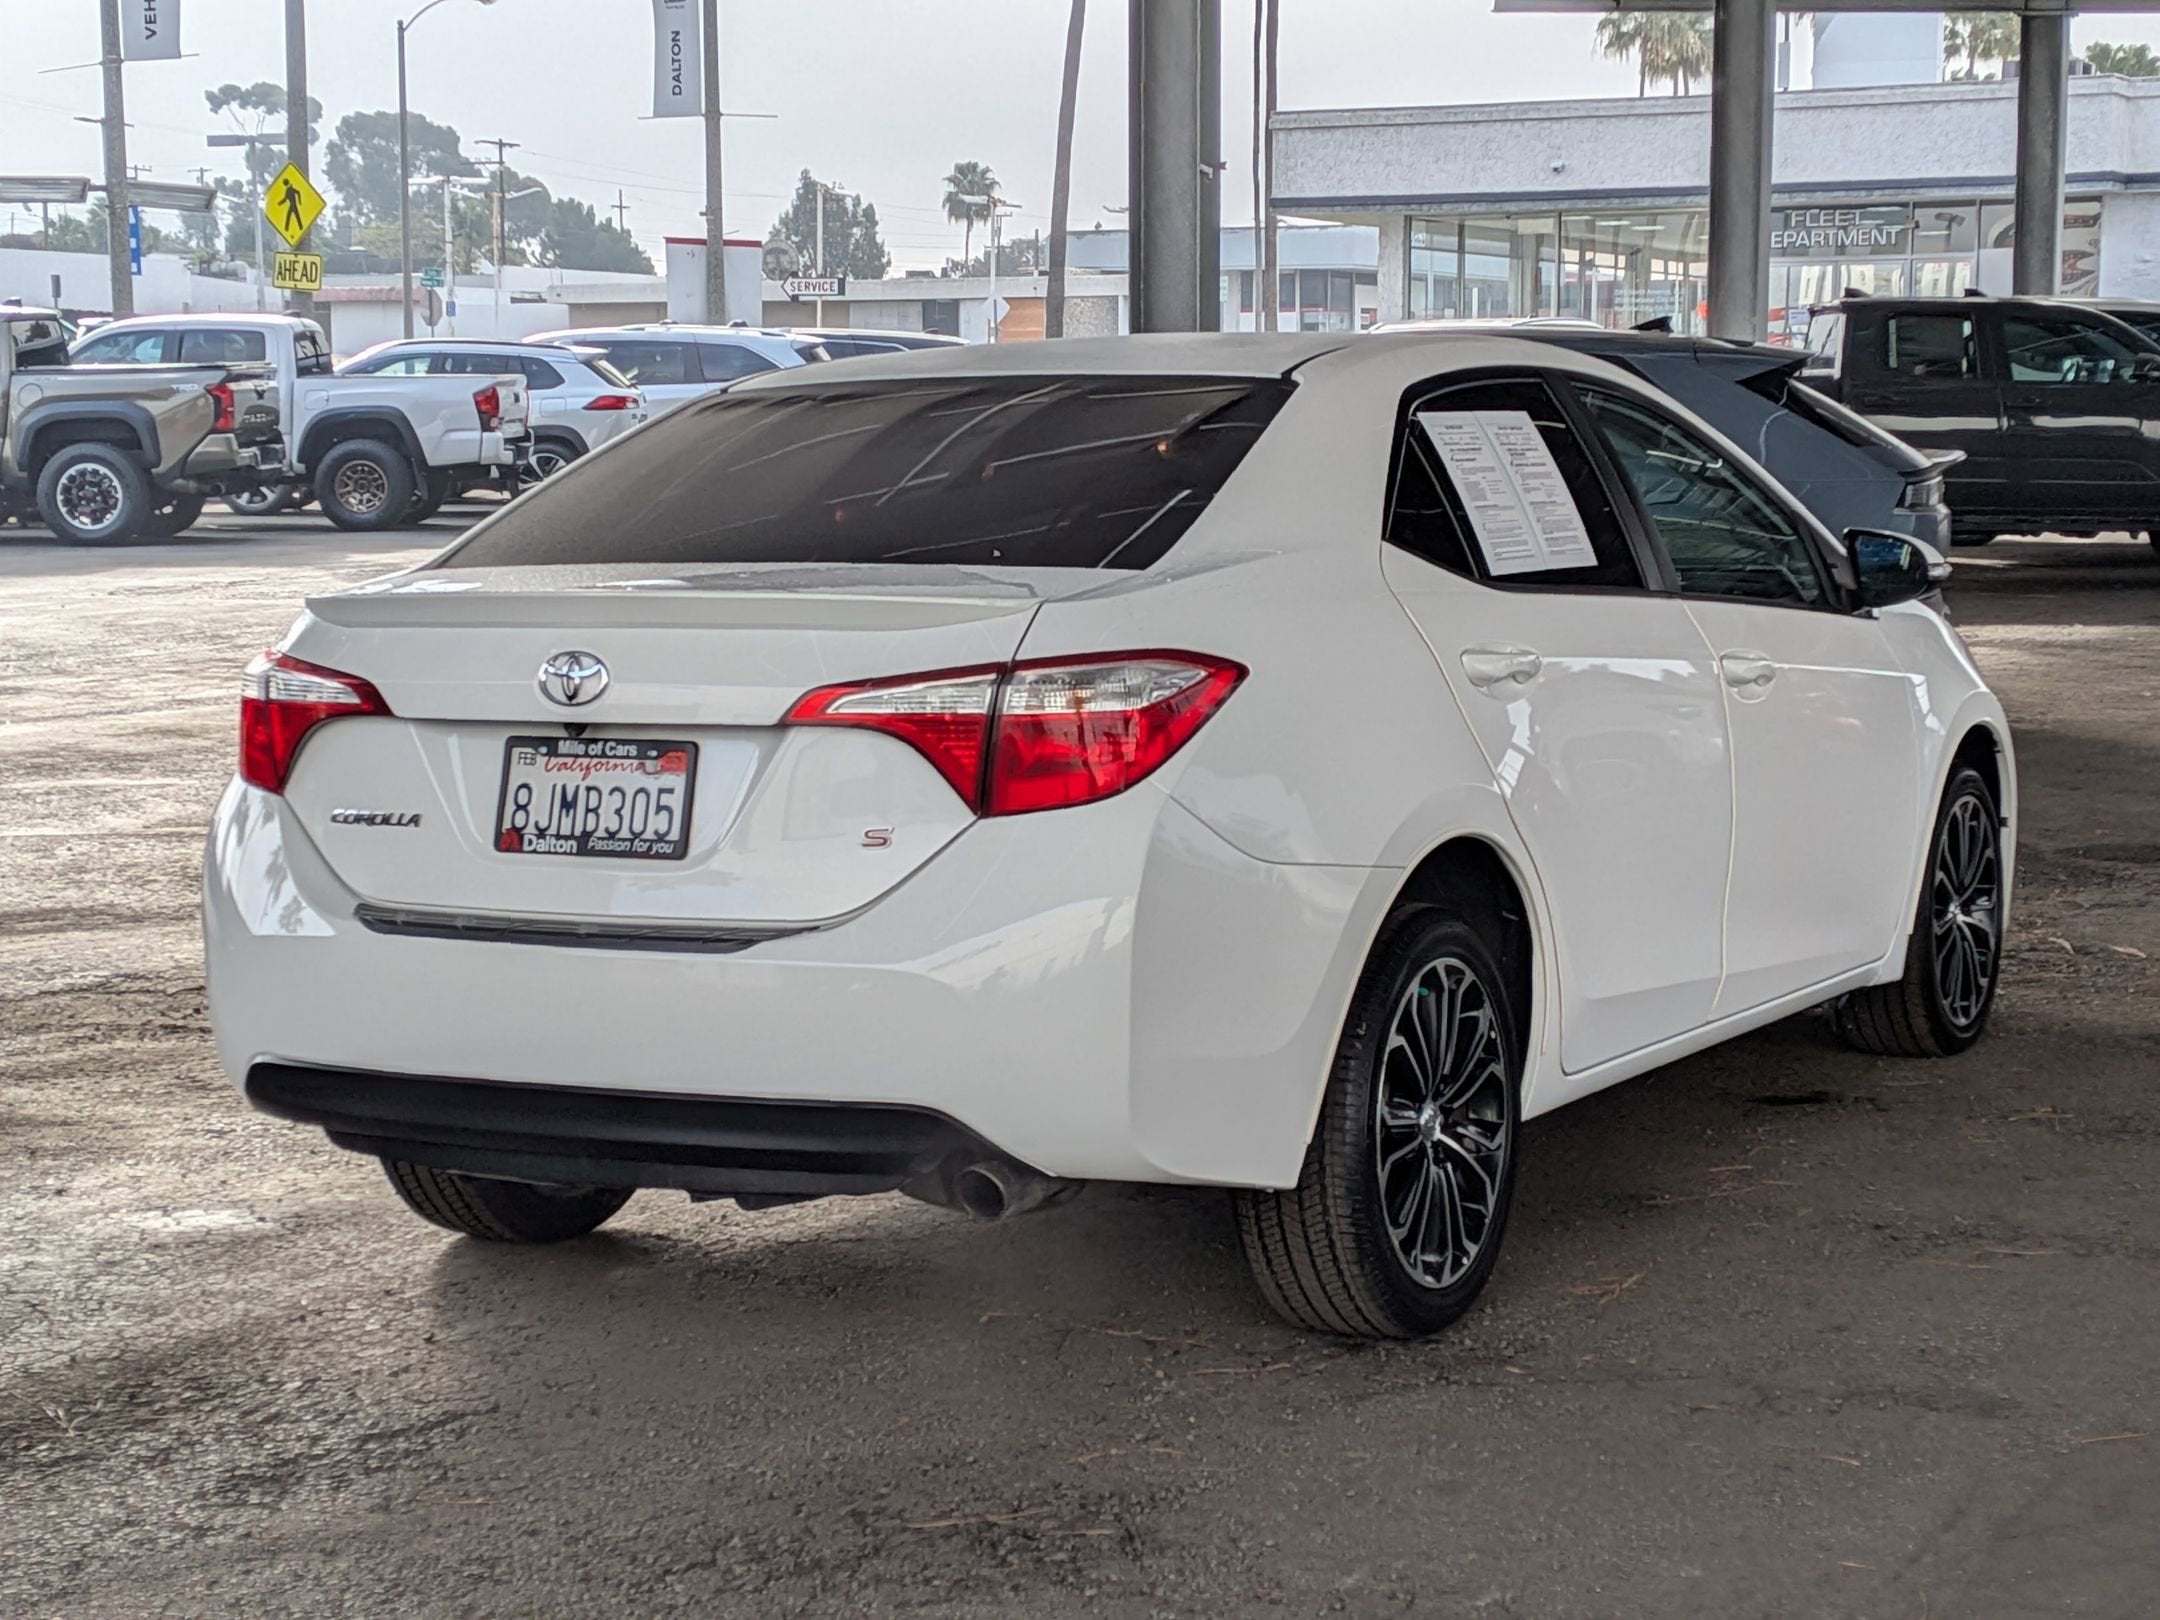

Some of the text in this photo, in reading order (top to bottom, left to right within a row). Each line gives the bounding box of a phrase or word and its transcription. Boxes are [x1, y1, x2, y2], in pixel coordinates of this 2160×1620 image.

[144, 0, 158, 40] VEH
[671, 30, 682, 96] DALTON
[1789, 208, 1863, 228] FLEET
[1770, 228, 1901, 248] EPARTMENT
[276, 260, 318, 283] AHEAD
[790, 280, 836, 292] SERVICE
[518, 751, 538, 766] FEB
[558, 740, 638, 757] Mile of Cars
[544, 755, 661, 780] California
[329, 808, 424, 828] COROLLA
[511, 783, 675, 838] 8JMB305
[522, 834, 674, 854] Dalton Passion for you
[861, 826, 896, 850] S
